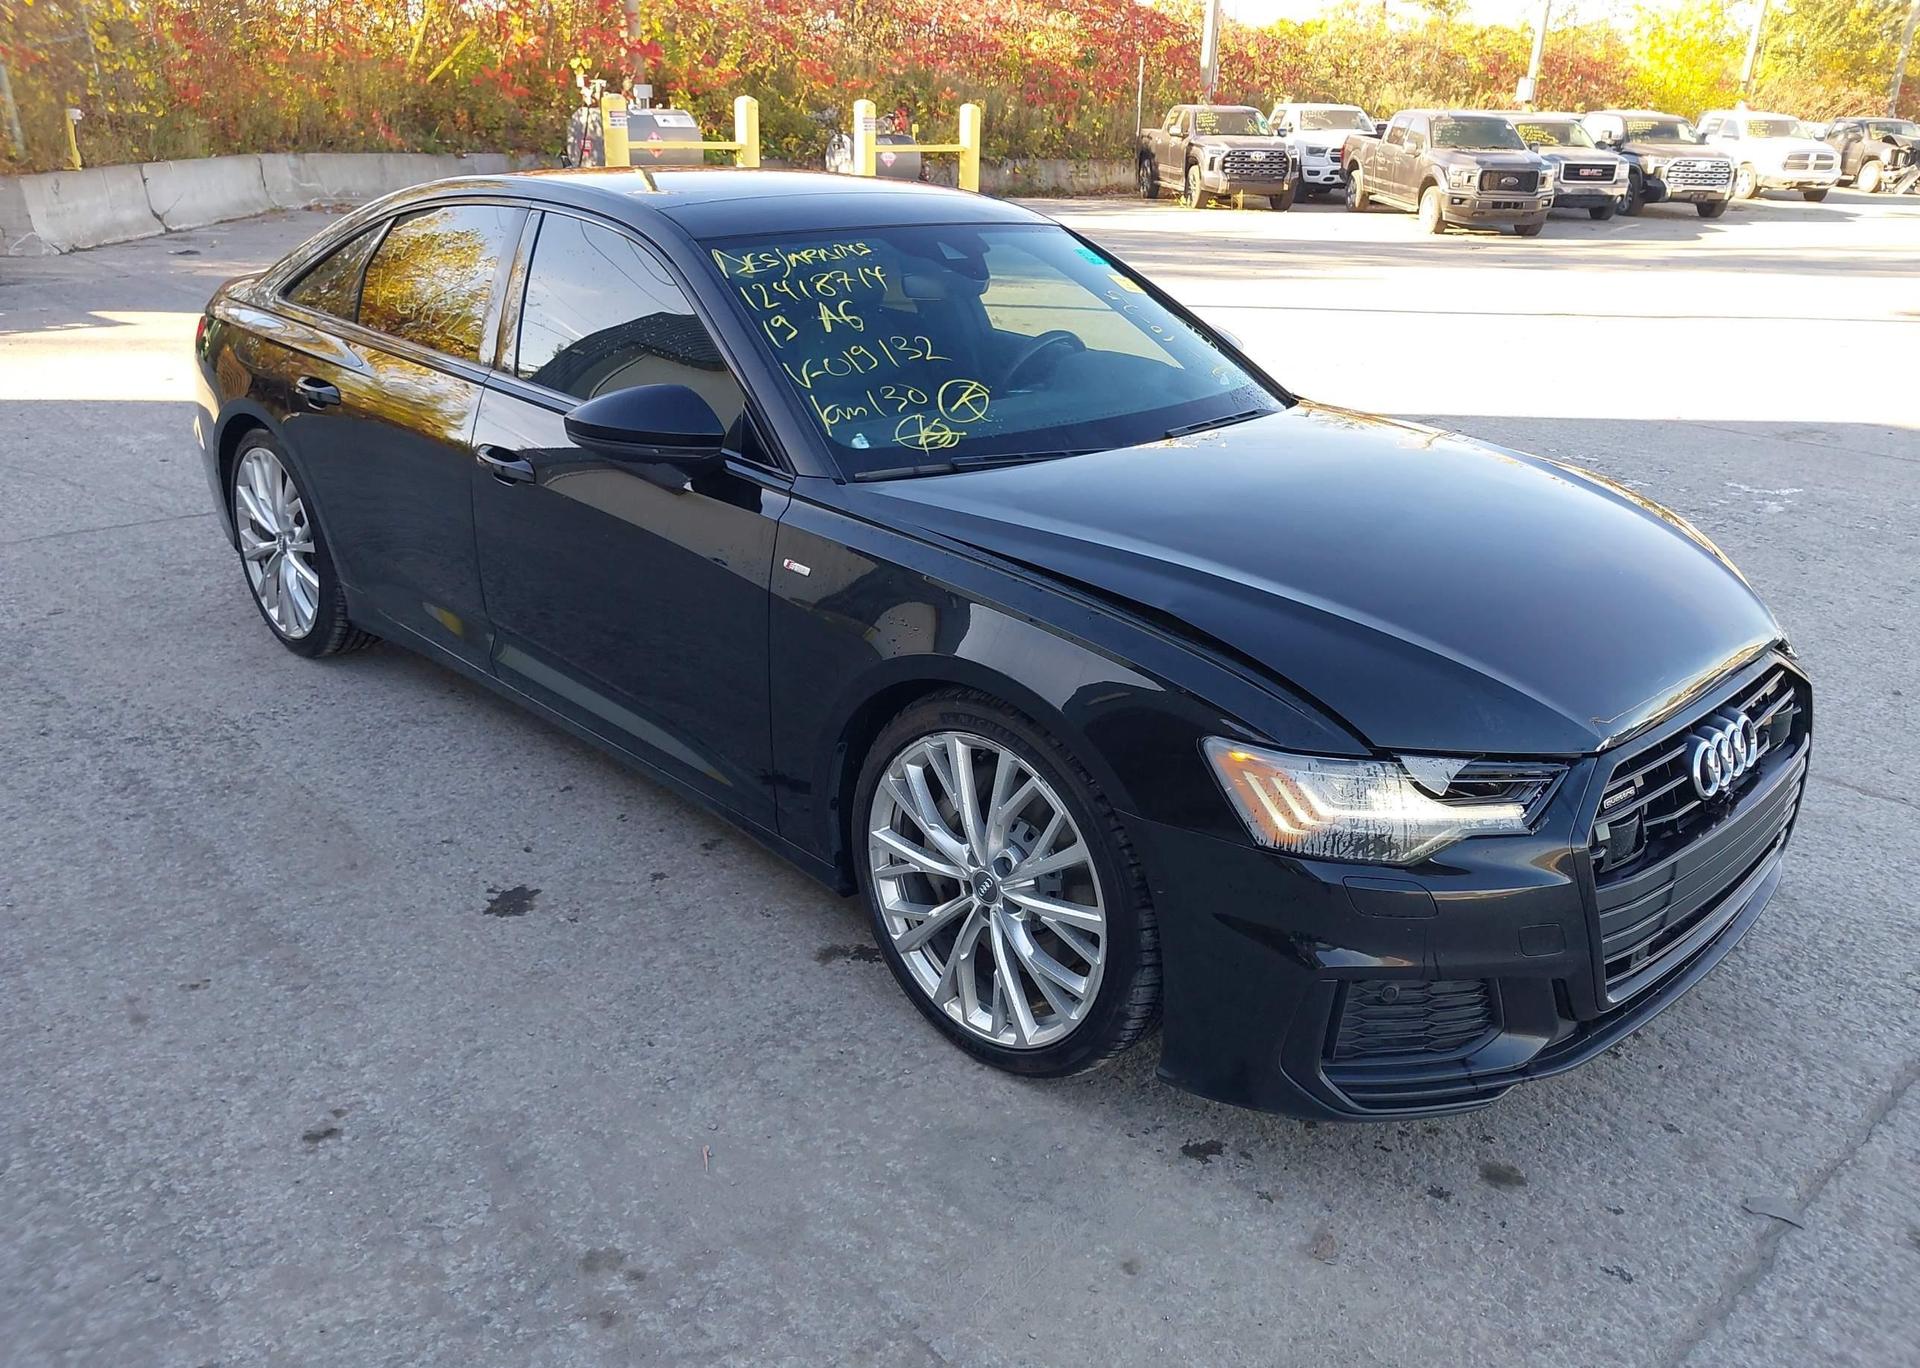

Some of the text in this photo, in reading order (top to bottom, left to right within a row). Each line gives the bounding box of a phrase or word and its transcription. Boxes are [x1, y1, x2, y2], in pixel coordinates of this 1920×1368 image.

[1579, 168, 1603, 176] GMC
[763, 300, 865, 349] 19 A6
[1604, 786, 1636, 809] quattro
